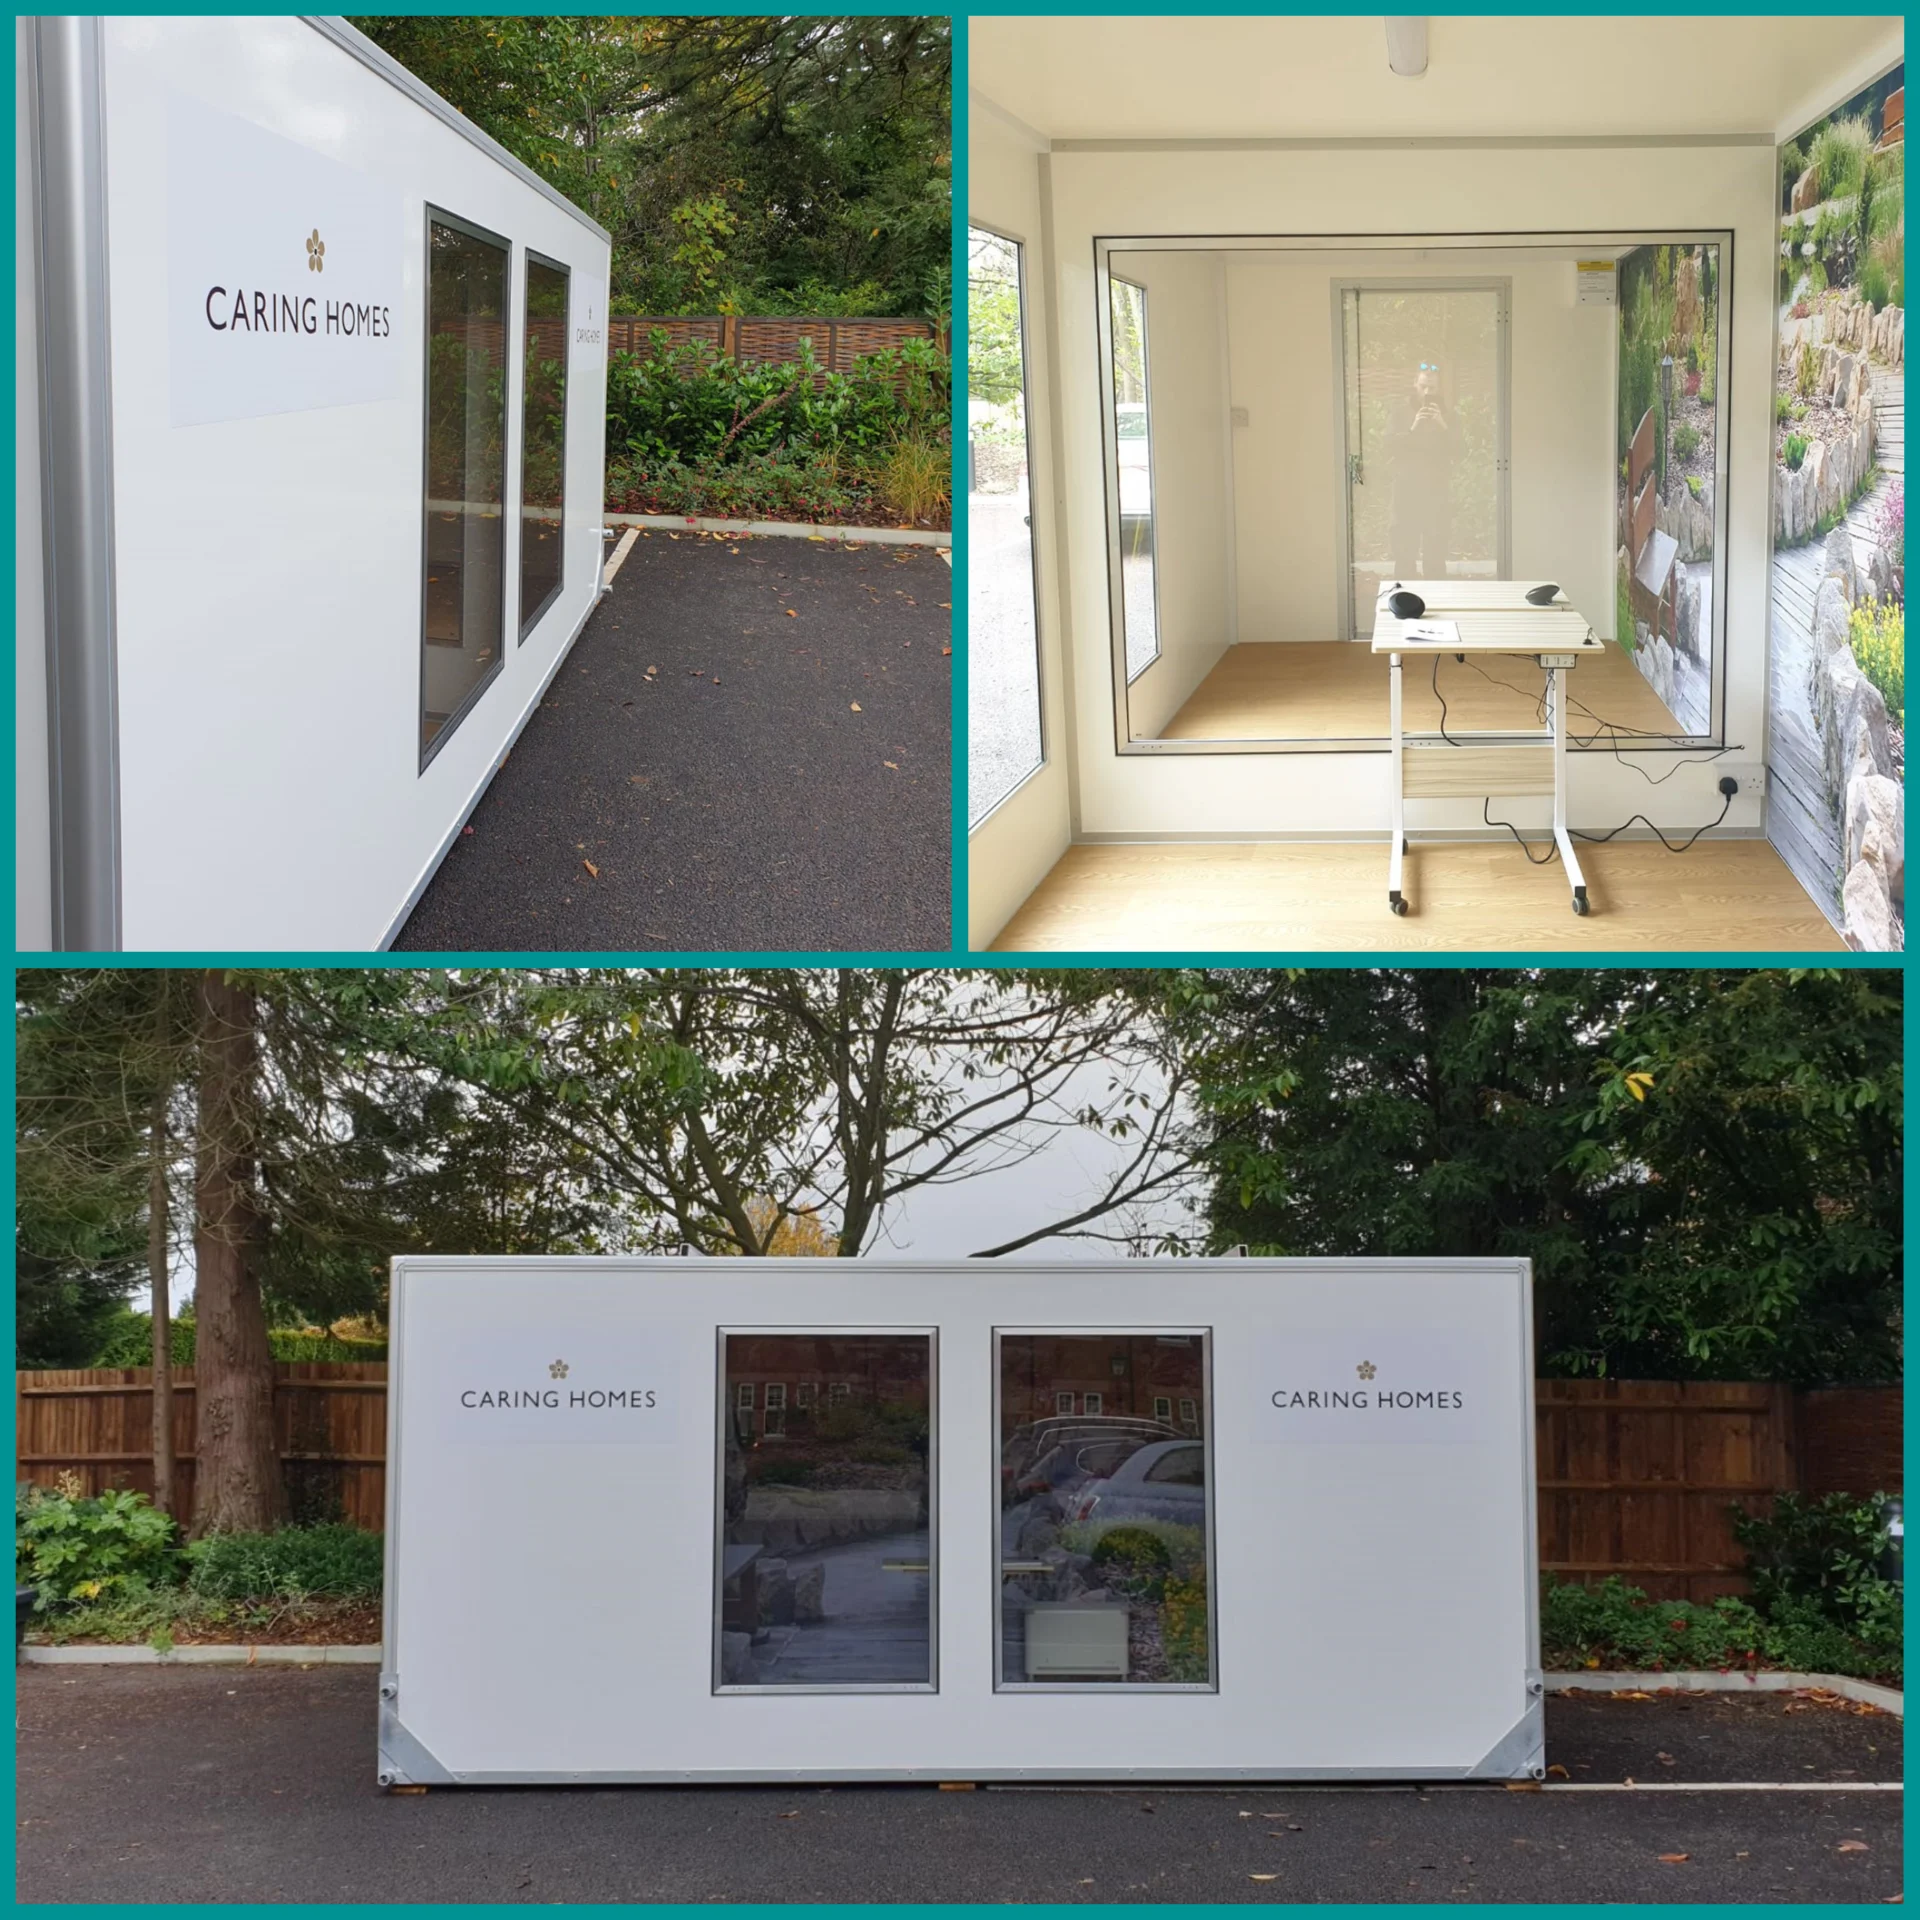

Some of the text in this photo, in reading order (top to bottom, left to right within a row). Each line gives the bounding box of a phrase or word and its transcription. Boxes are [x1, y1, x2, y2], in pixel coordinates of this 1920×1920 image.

[206, 286, 390, 337] CARING HOMES
[461, 1390, 656, 1408] CARING HOMES
[1271, 1390, 1462, 1409] CARING HOMES
